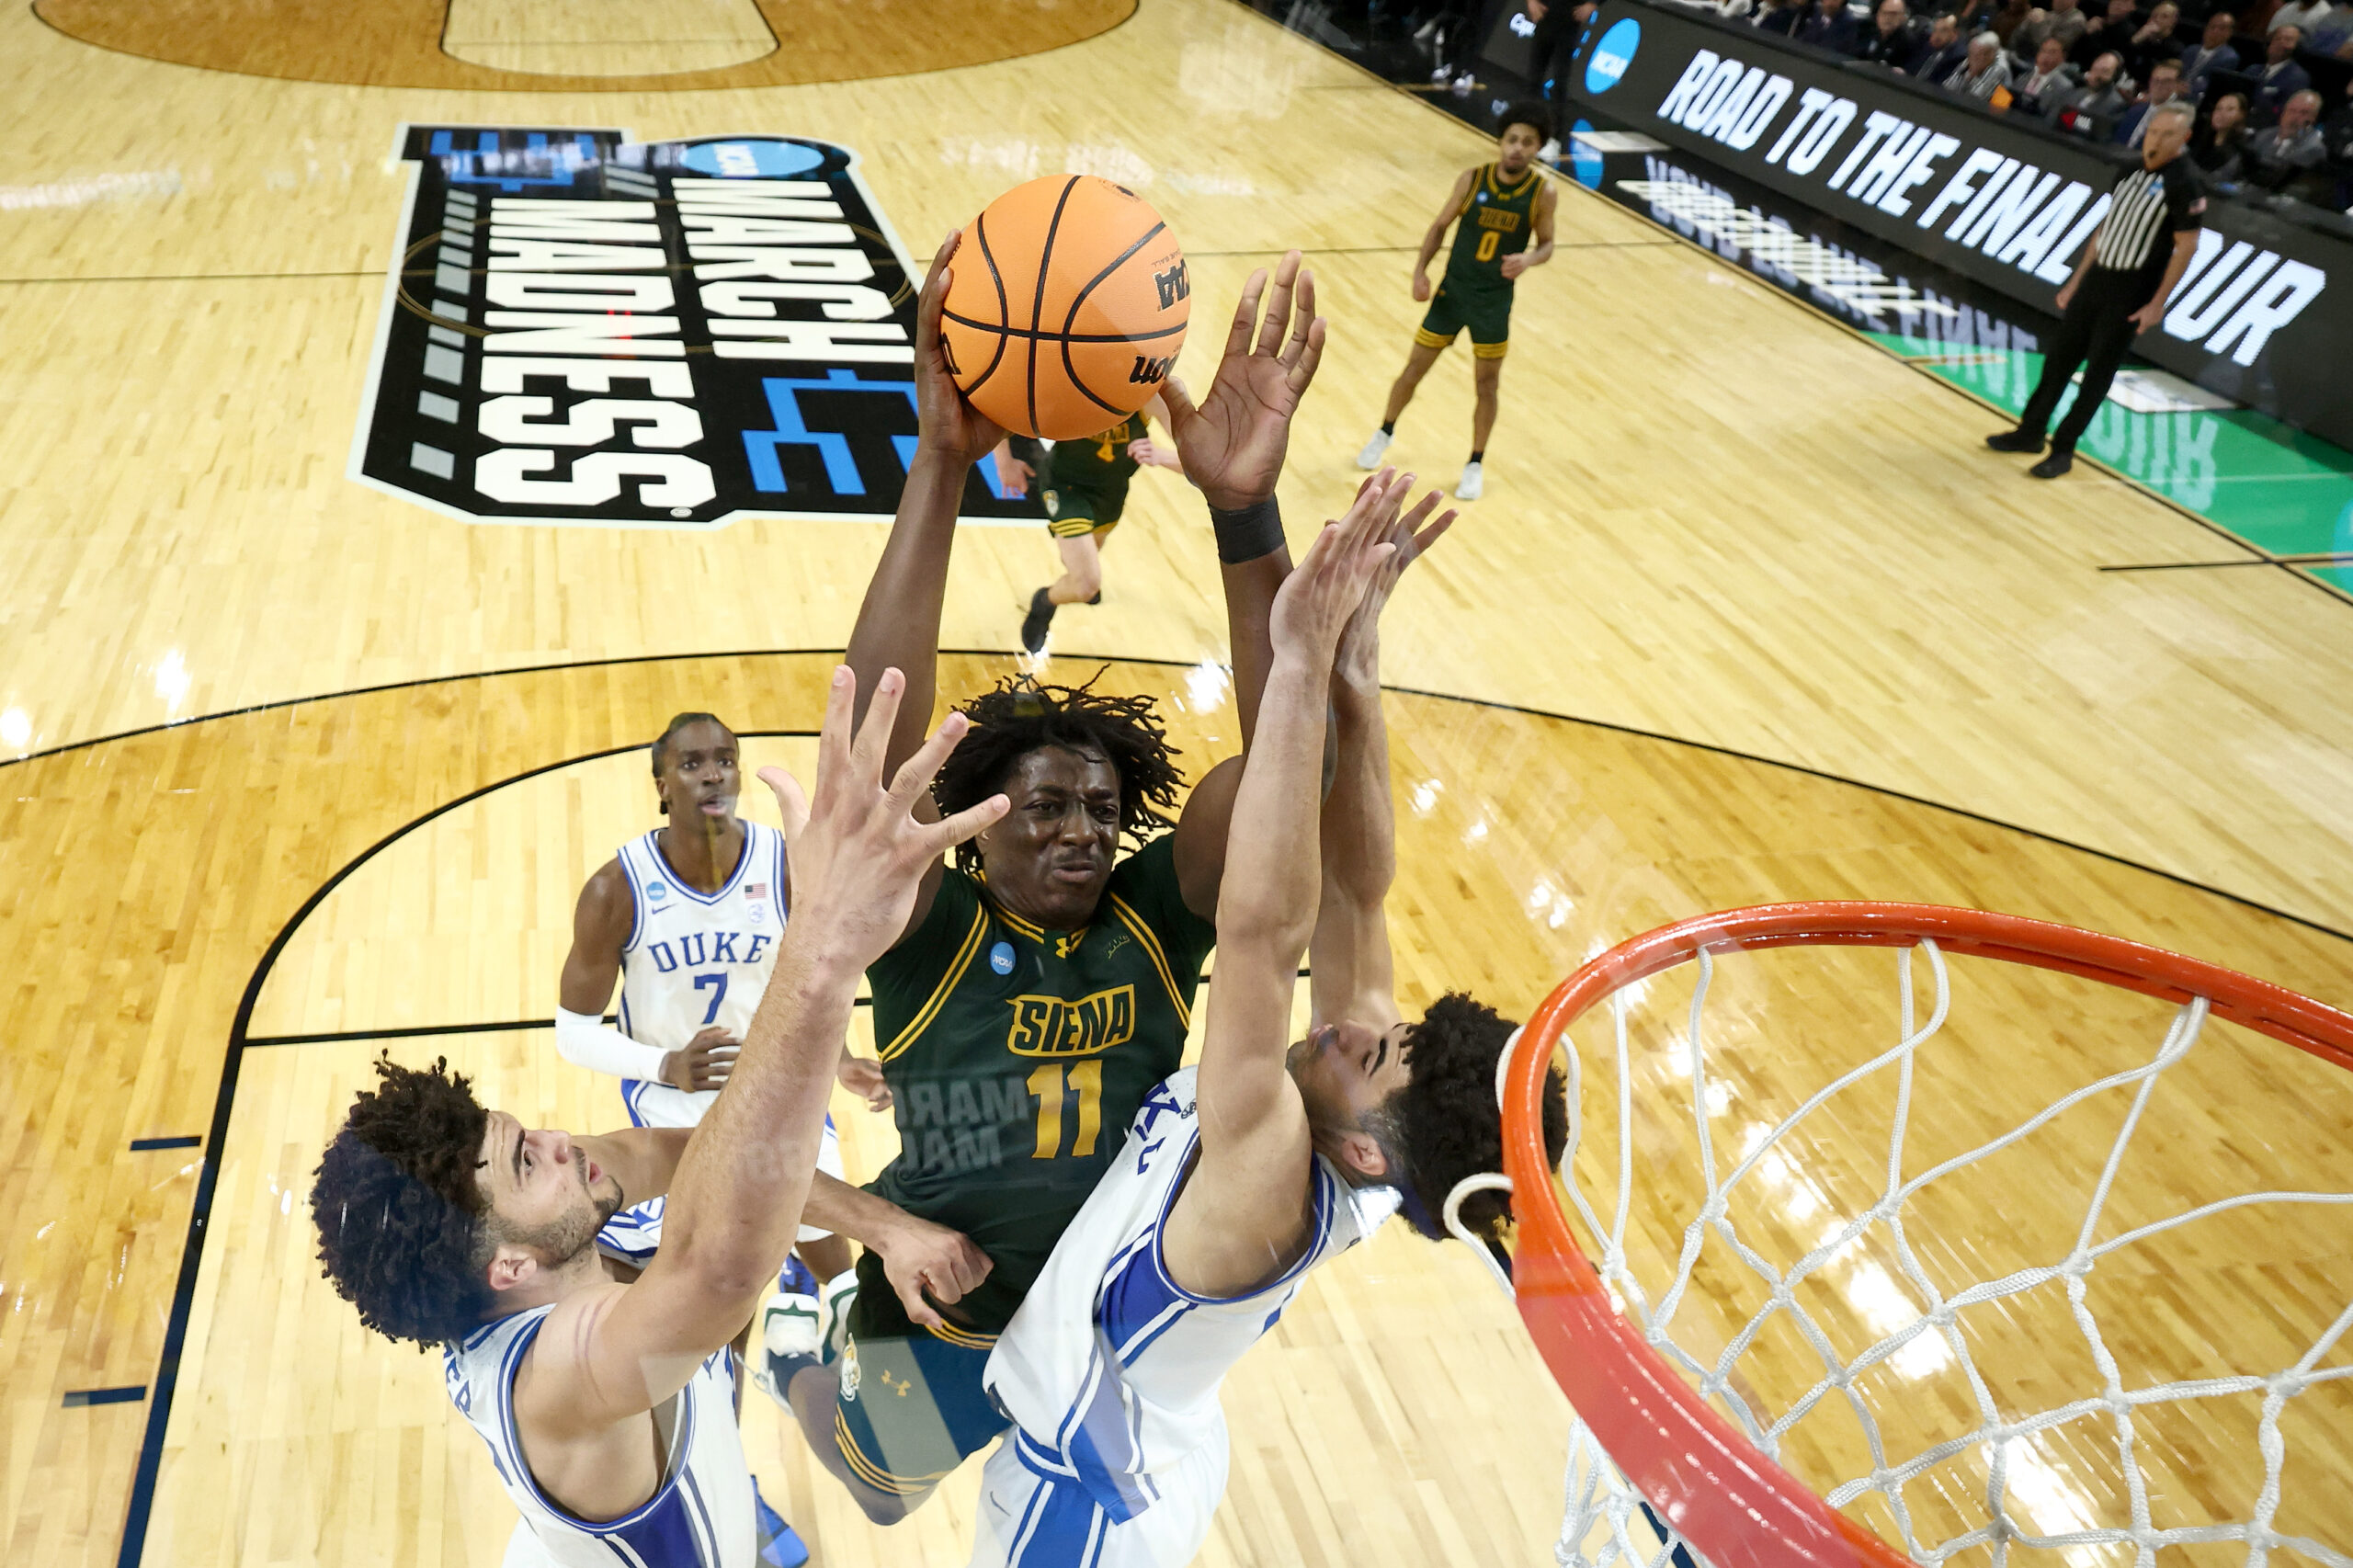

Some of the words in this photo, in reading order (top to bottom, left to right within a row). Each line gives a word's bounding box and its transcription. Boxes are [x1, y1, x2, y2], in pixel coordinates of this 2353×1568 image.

[1656, 48, 1794, 151] ROAD
[1764, 86, 1859, 176] TO
[1826, 109, 1961, 218] THE
[1915, 147, 2112, 286] FINAL
[670, 177, 916, 363] MARCH
[1476, 232, 1500, 262] 0
[474, 197, 718, 506] MADNESS
[647, 931, 771, 972] DUKE
[694, 971, 728, 1024] 7
[1012, 990, 1131, 1053] SIENA
[1026, 1059, 1103, 1159] 11
